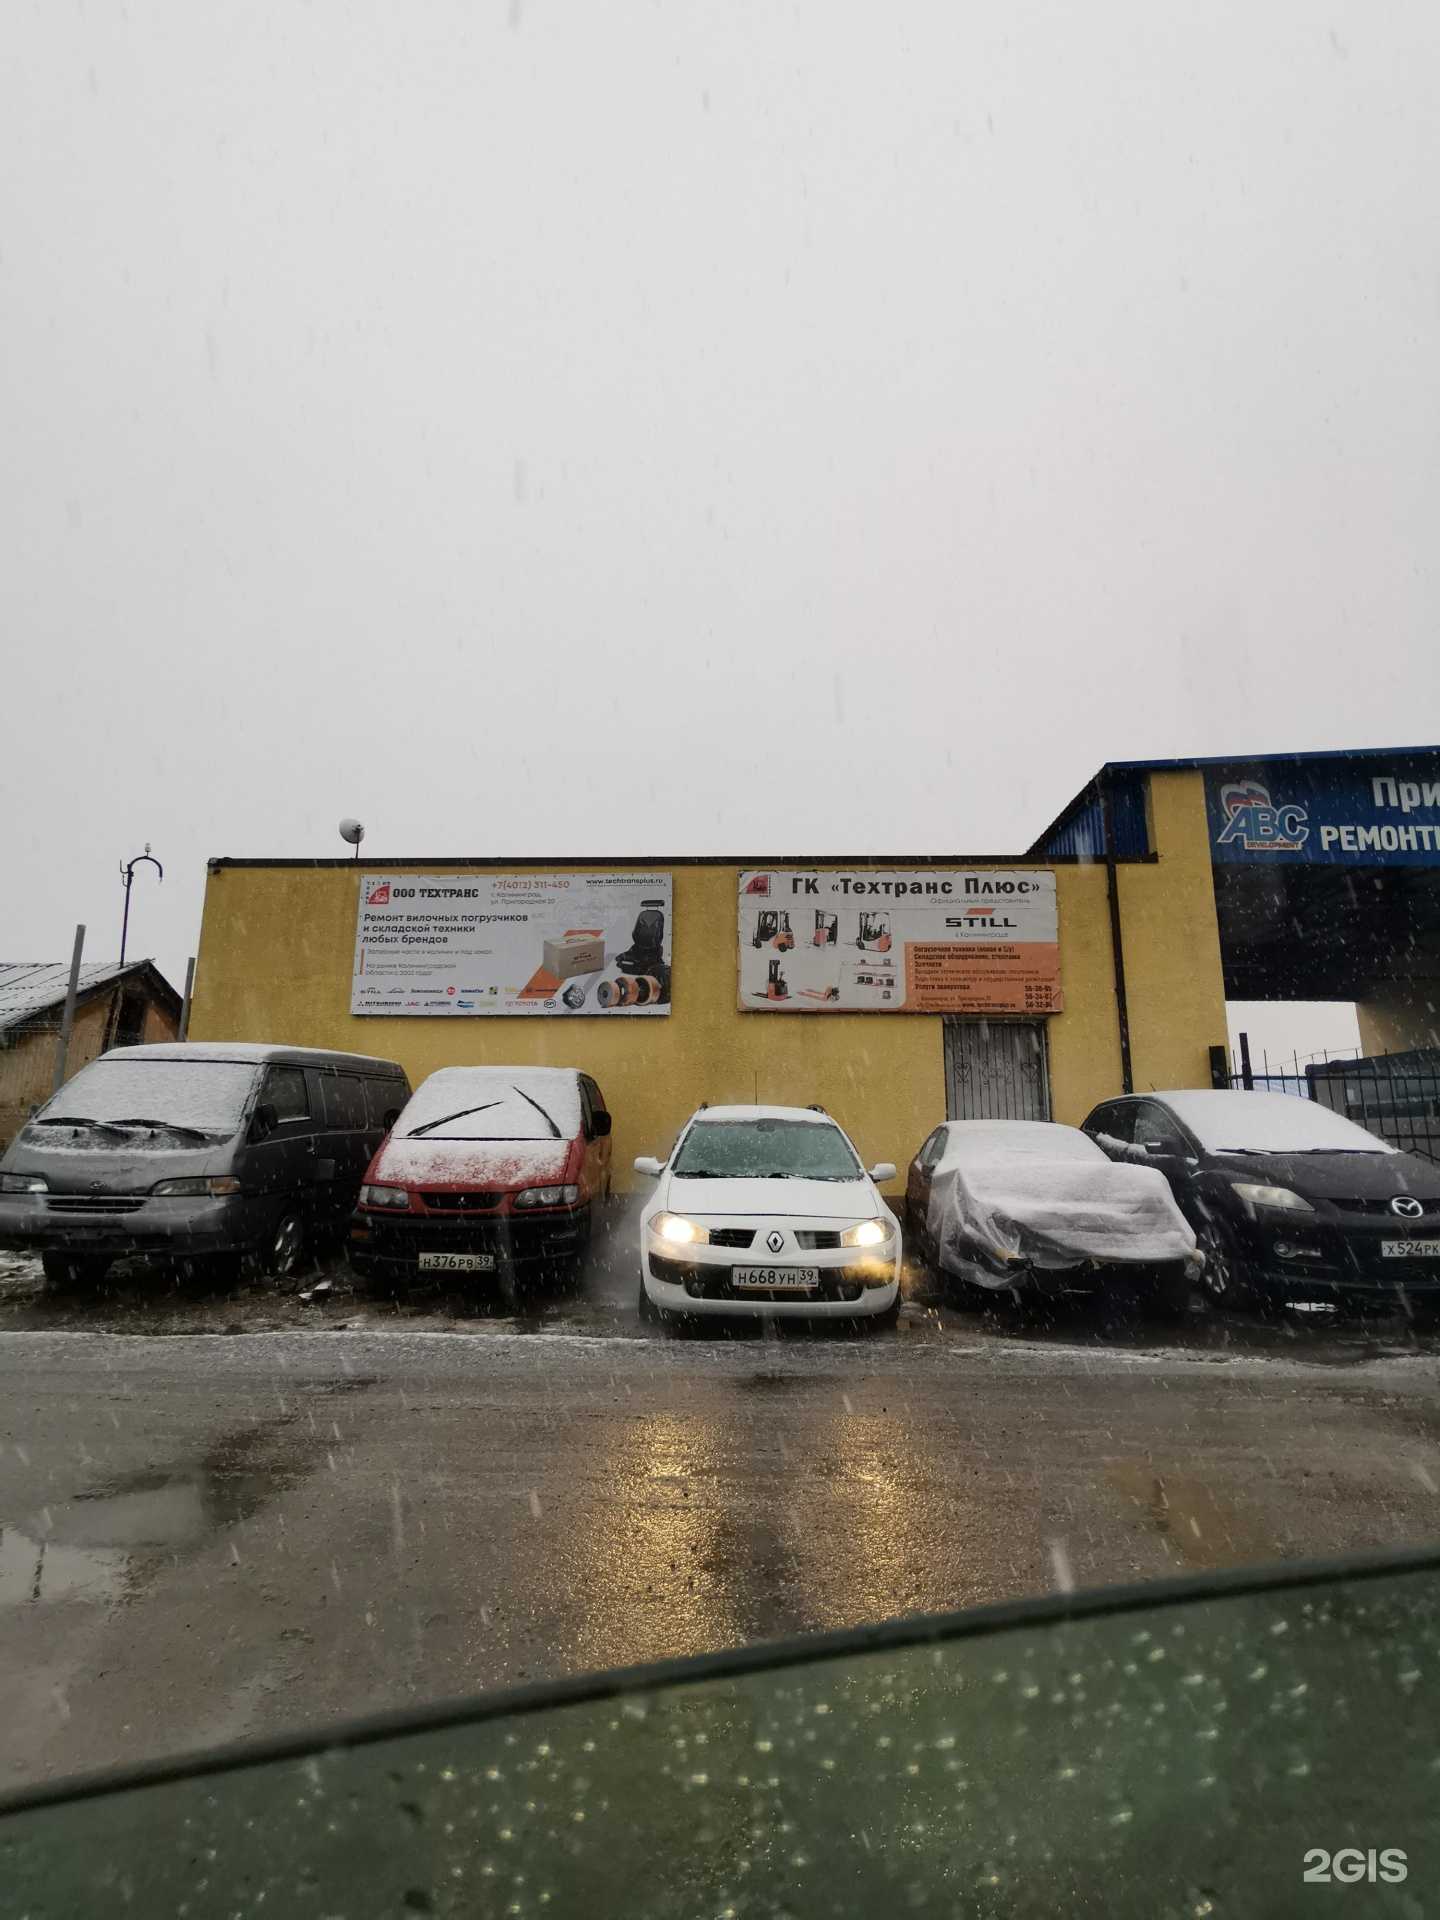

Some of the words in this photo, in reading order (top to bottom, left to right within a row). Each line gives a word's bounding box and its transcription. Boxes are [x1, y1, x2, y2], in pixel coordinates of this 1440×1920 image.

[1320, 825, 1440, 851] РЕМОНТ
[792, 877, 820, 894] ГК
[831, 877, 953, 898] «Техтранс
[964, 877, 1040, 895] Плюс»
[419, 888, 480, 898] ТЕХТРАНС
[364, 914, 404, 922] Ремонт
[406, 914, 459, 922] вилочных
[461, 914, 528, 924] погрузчиков
[945, 917, 1018, 928] STILL
[372, 924, 430, 934] складской
[433, 925, 476, 933] техники
[362, 935, 399, 944] любых
[401, 935, 449, 944] брендов
[799, 1269, 814, 1281] 39
